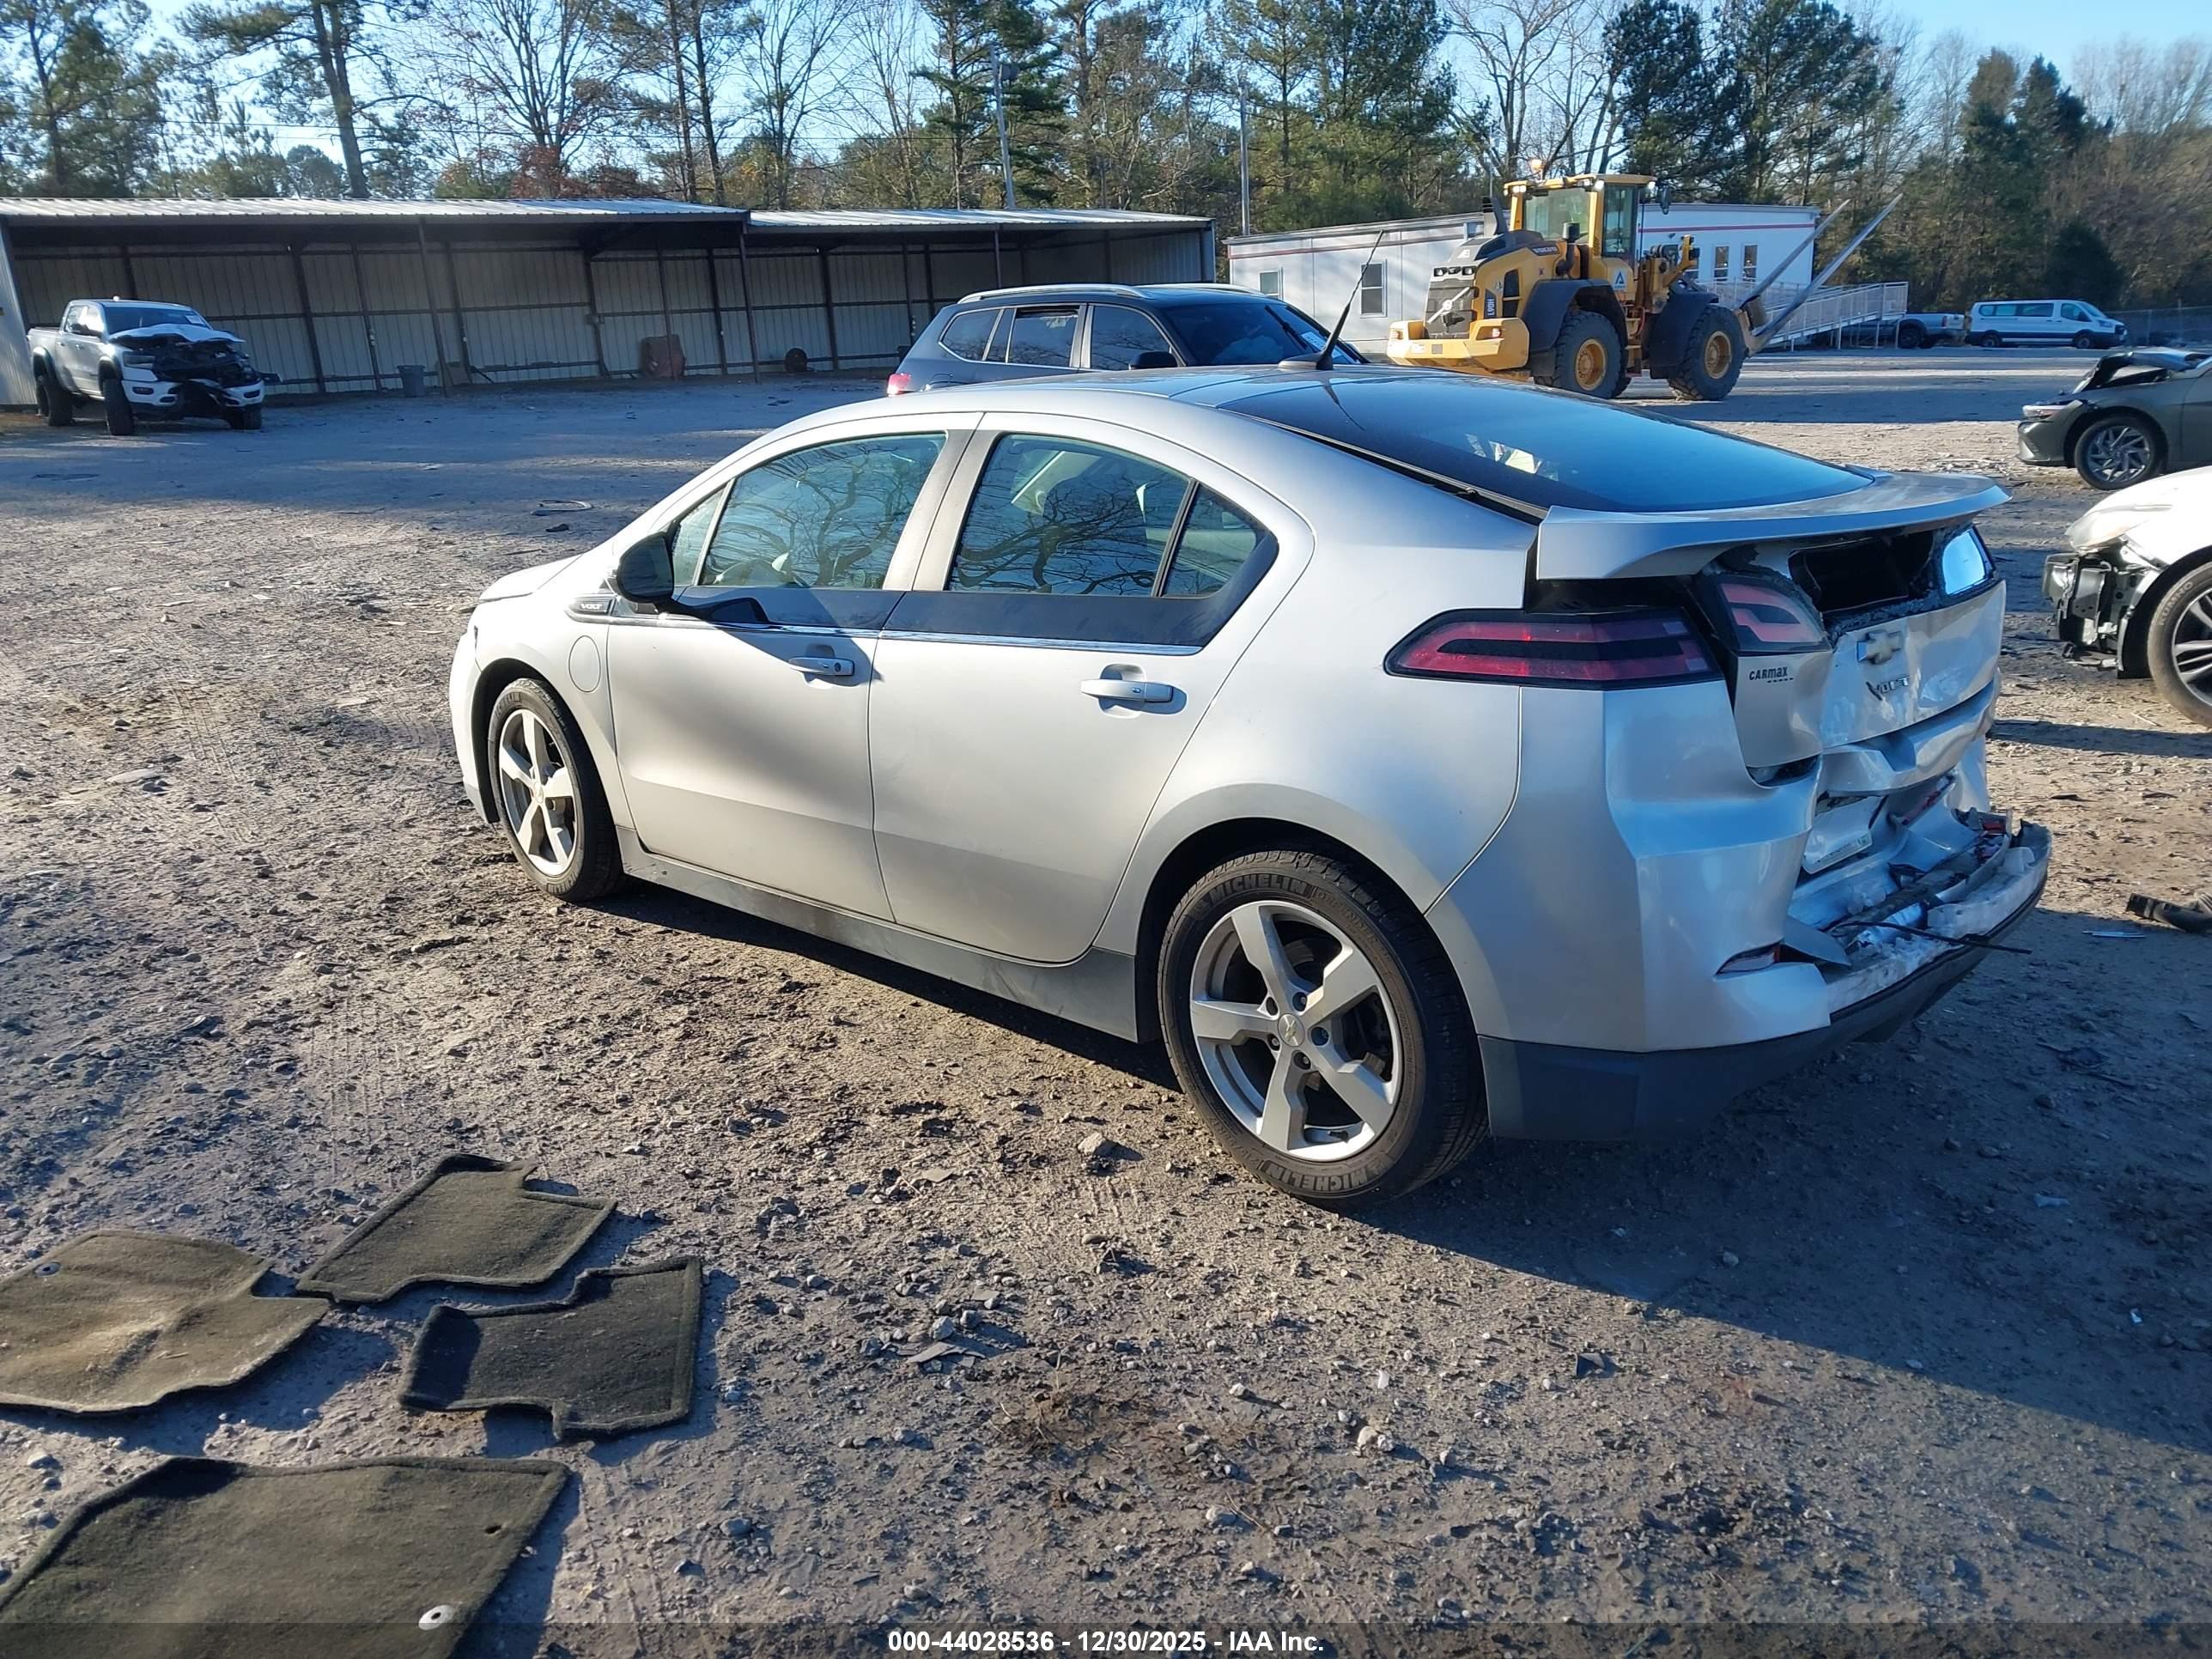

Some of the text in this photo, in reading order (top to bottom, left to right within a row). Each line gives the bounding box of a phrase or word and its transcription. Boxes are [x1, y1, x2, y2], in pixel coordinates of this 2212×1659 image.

[2157, 581, 2193, 626] KUMHO
[1210, 873, 1306, 899] MICHELIN
[1266, 1162, 1368, 1192] MICHELIN
